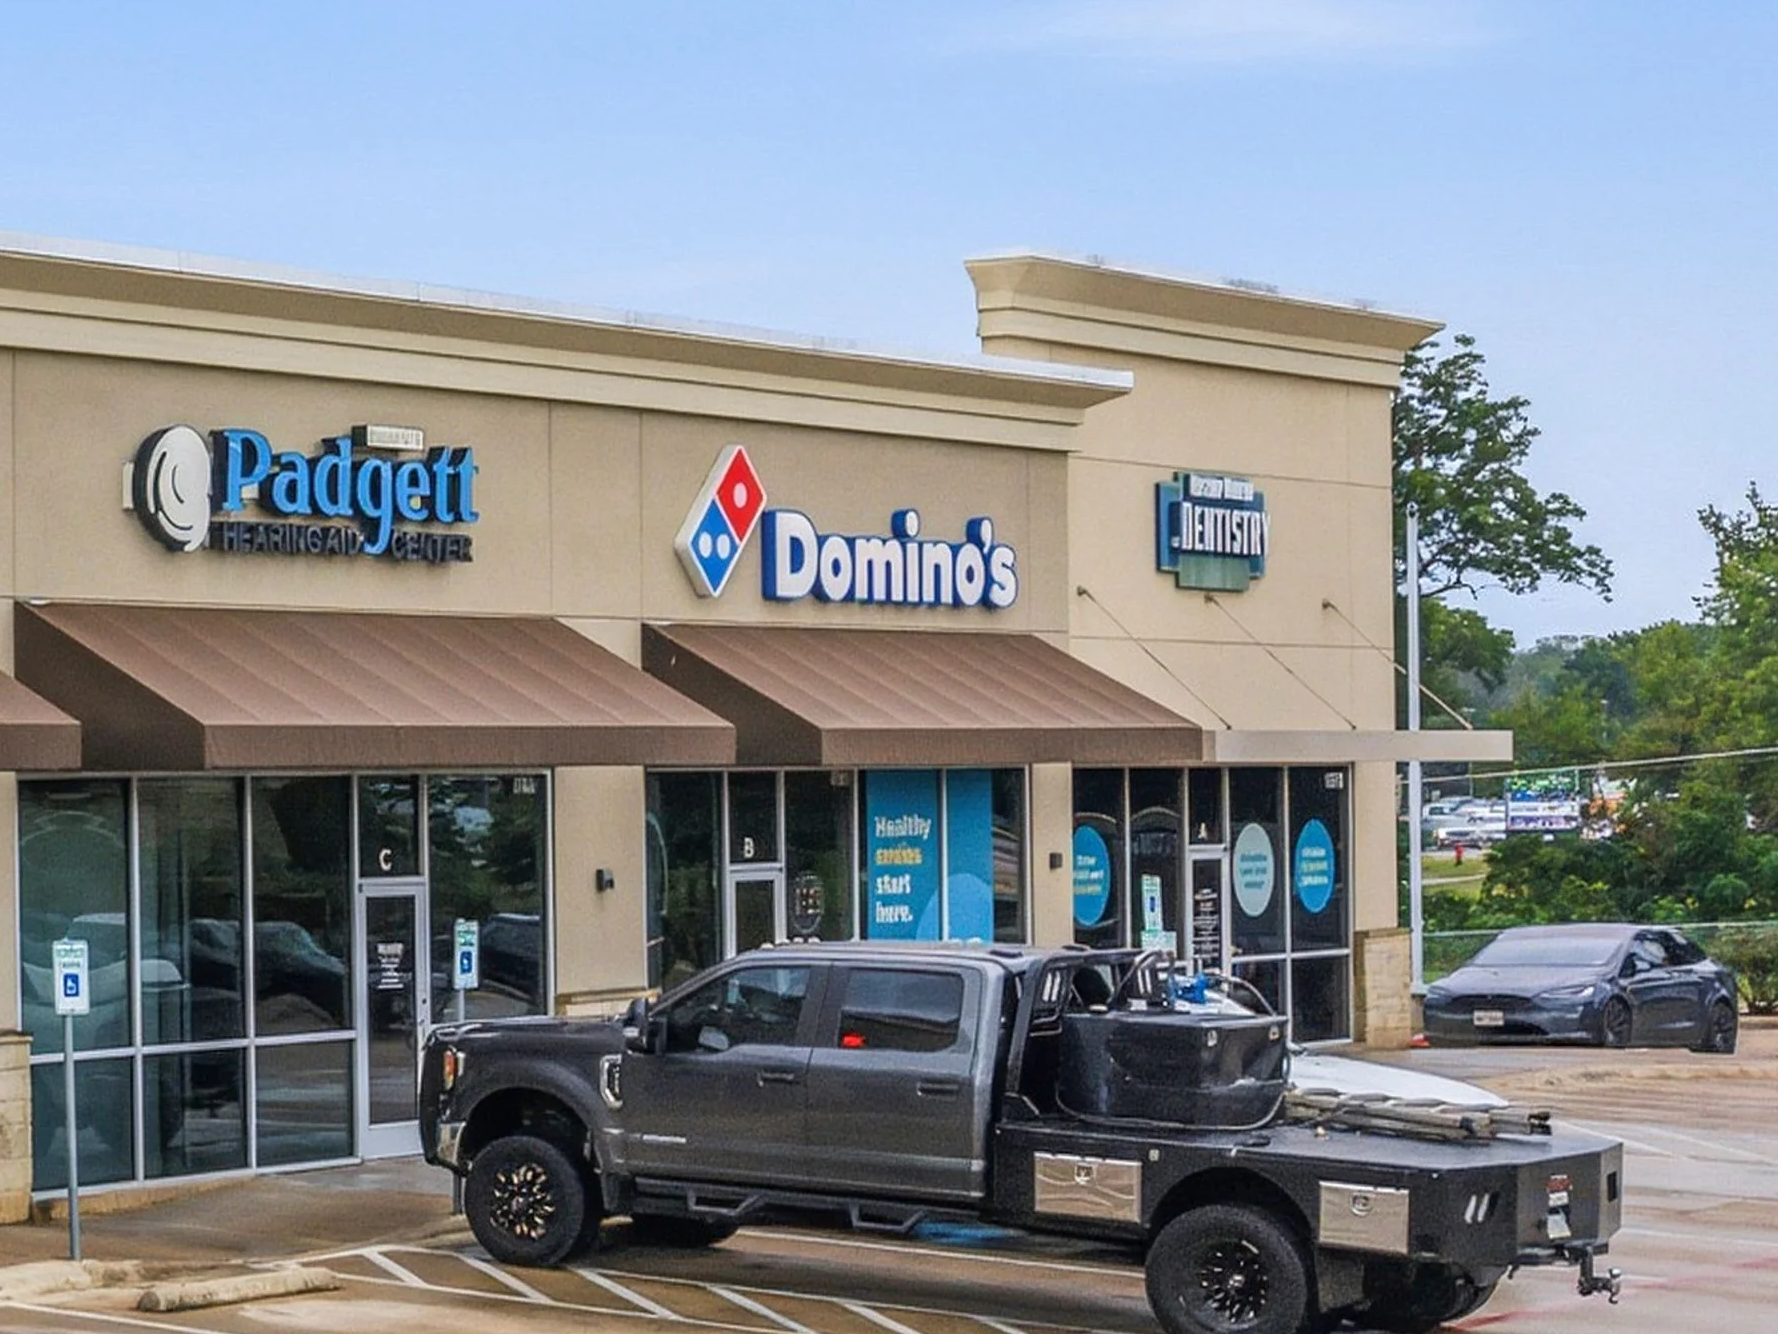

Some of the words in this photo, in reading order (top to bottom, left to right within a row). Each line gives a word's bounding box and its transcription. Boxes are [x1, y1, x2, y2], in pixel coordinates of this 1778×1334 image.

[221, 428, 479, 555] Padgett
[1181, 501, 1271, 557] DENTISTRY
[222, 525, 323, 555] HEARING
[326, 528, 364, 557] AID
[391, 530, 473, 563] CENTER
[773, 509, 1019, 608] Domino's
[874, 814, 932, 841] Healthy
[1198, 822, 1208, 840] A
[378, 848, 393, 872] C
[743, 837, 755, 859] B
[876, 874, 912, 896] start
[875, 902, 914, 924] here.
